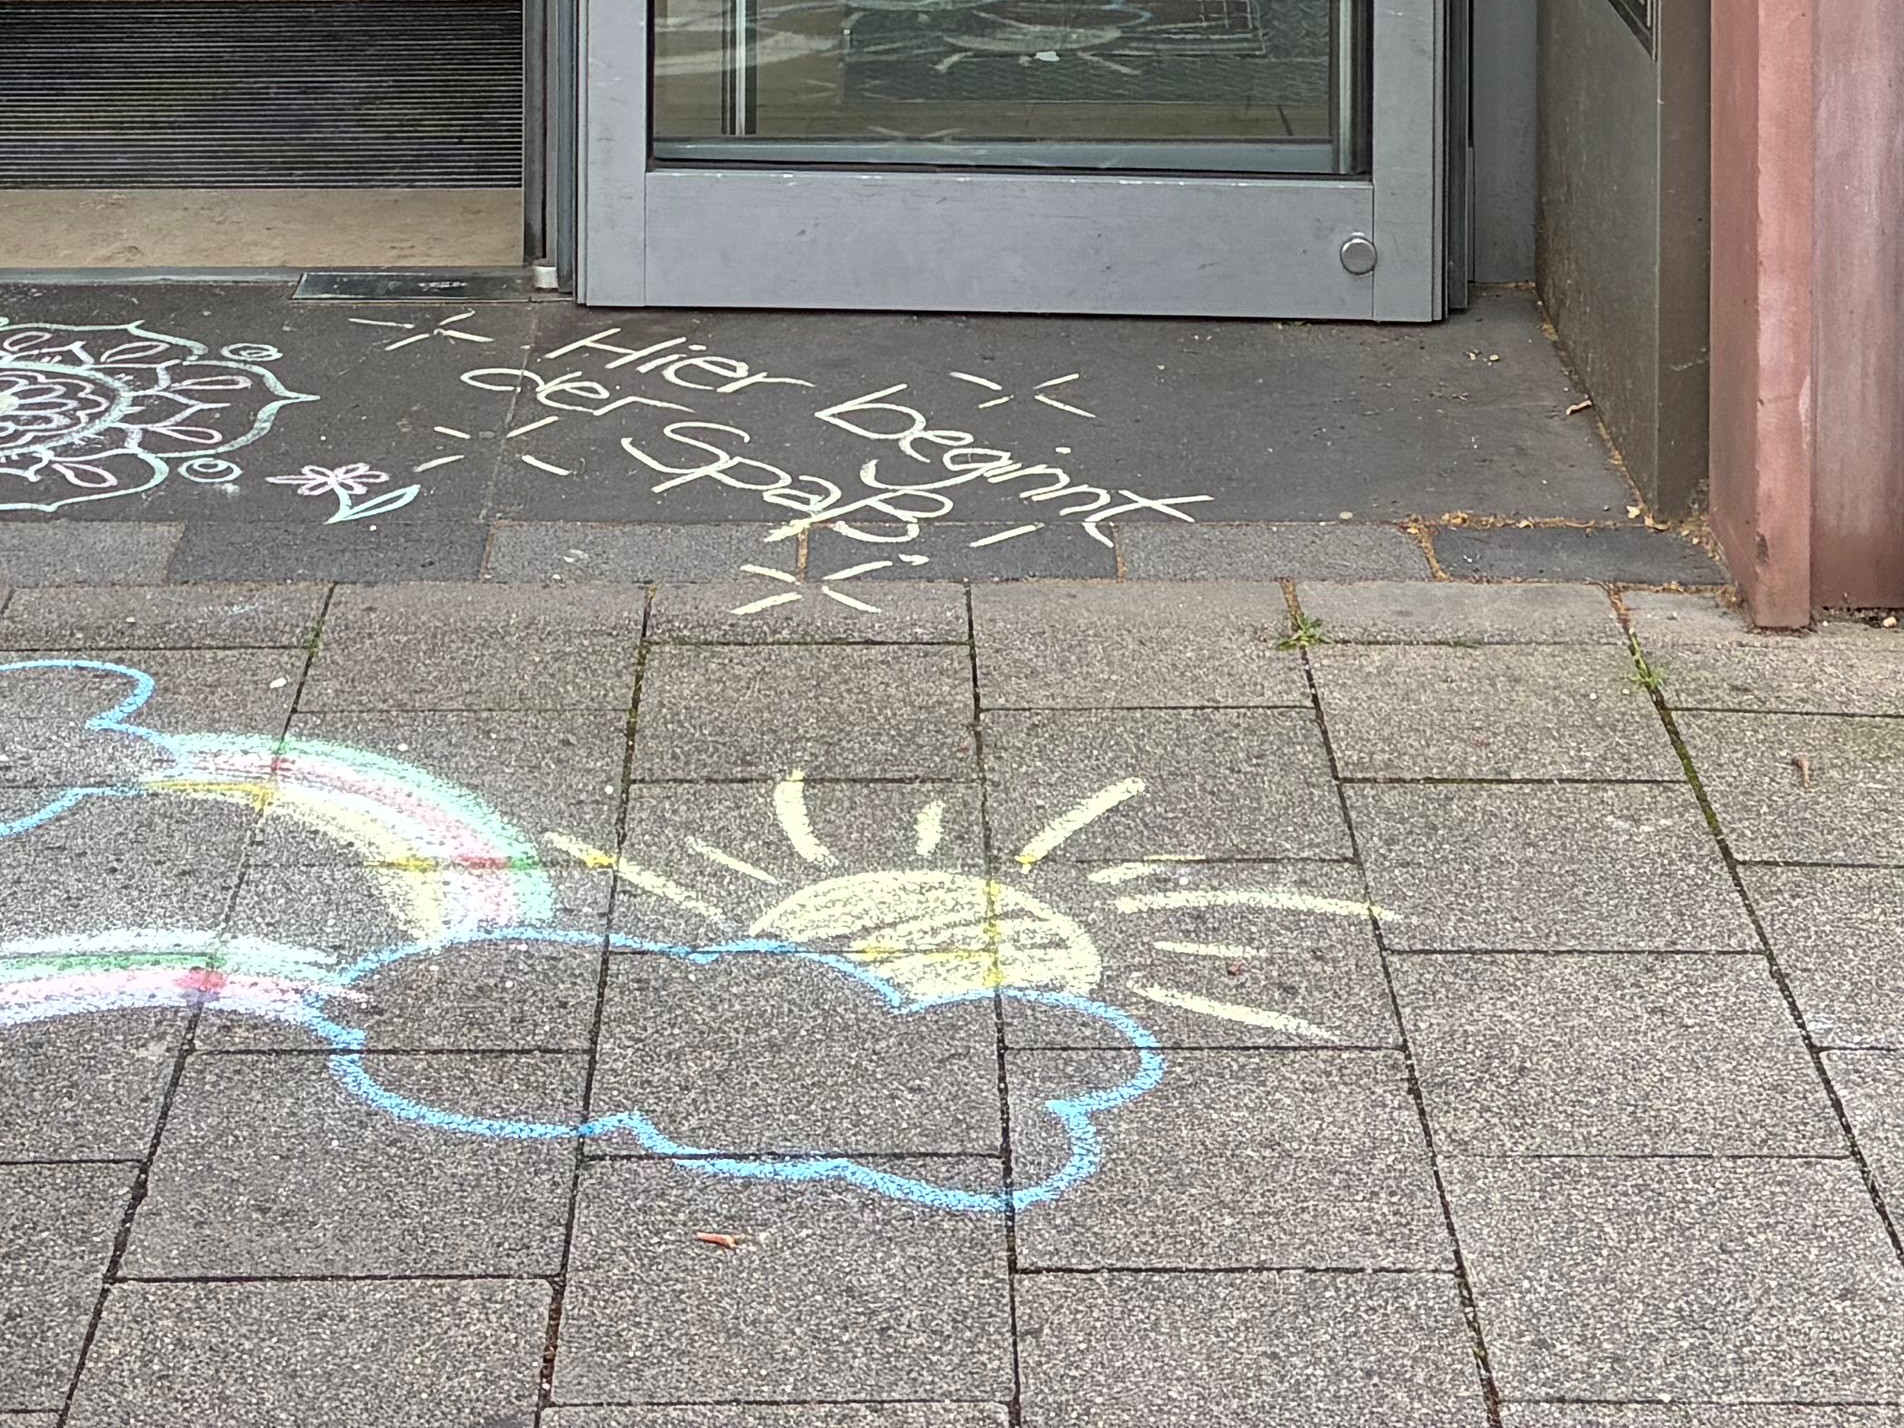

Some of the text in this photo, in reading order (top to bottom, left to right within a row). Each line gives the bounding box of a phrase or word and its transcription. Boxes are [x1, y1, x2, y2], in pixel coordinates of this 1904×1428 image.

[460, 367, 696, 416] der
[544, 327, 1214, 548] Hier beginnt
